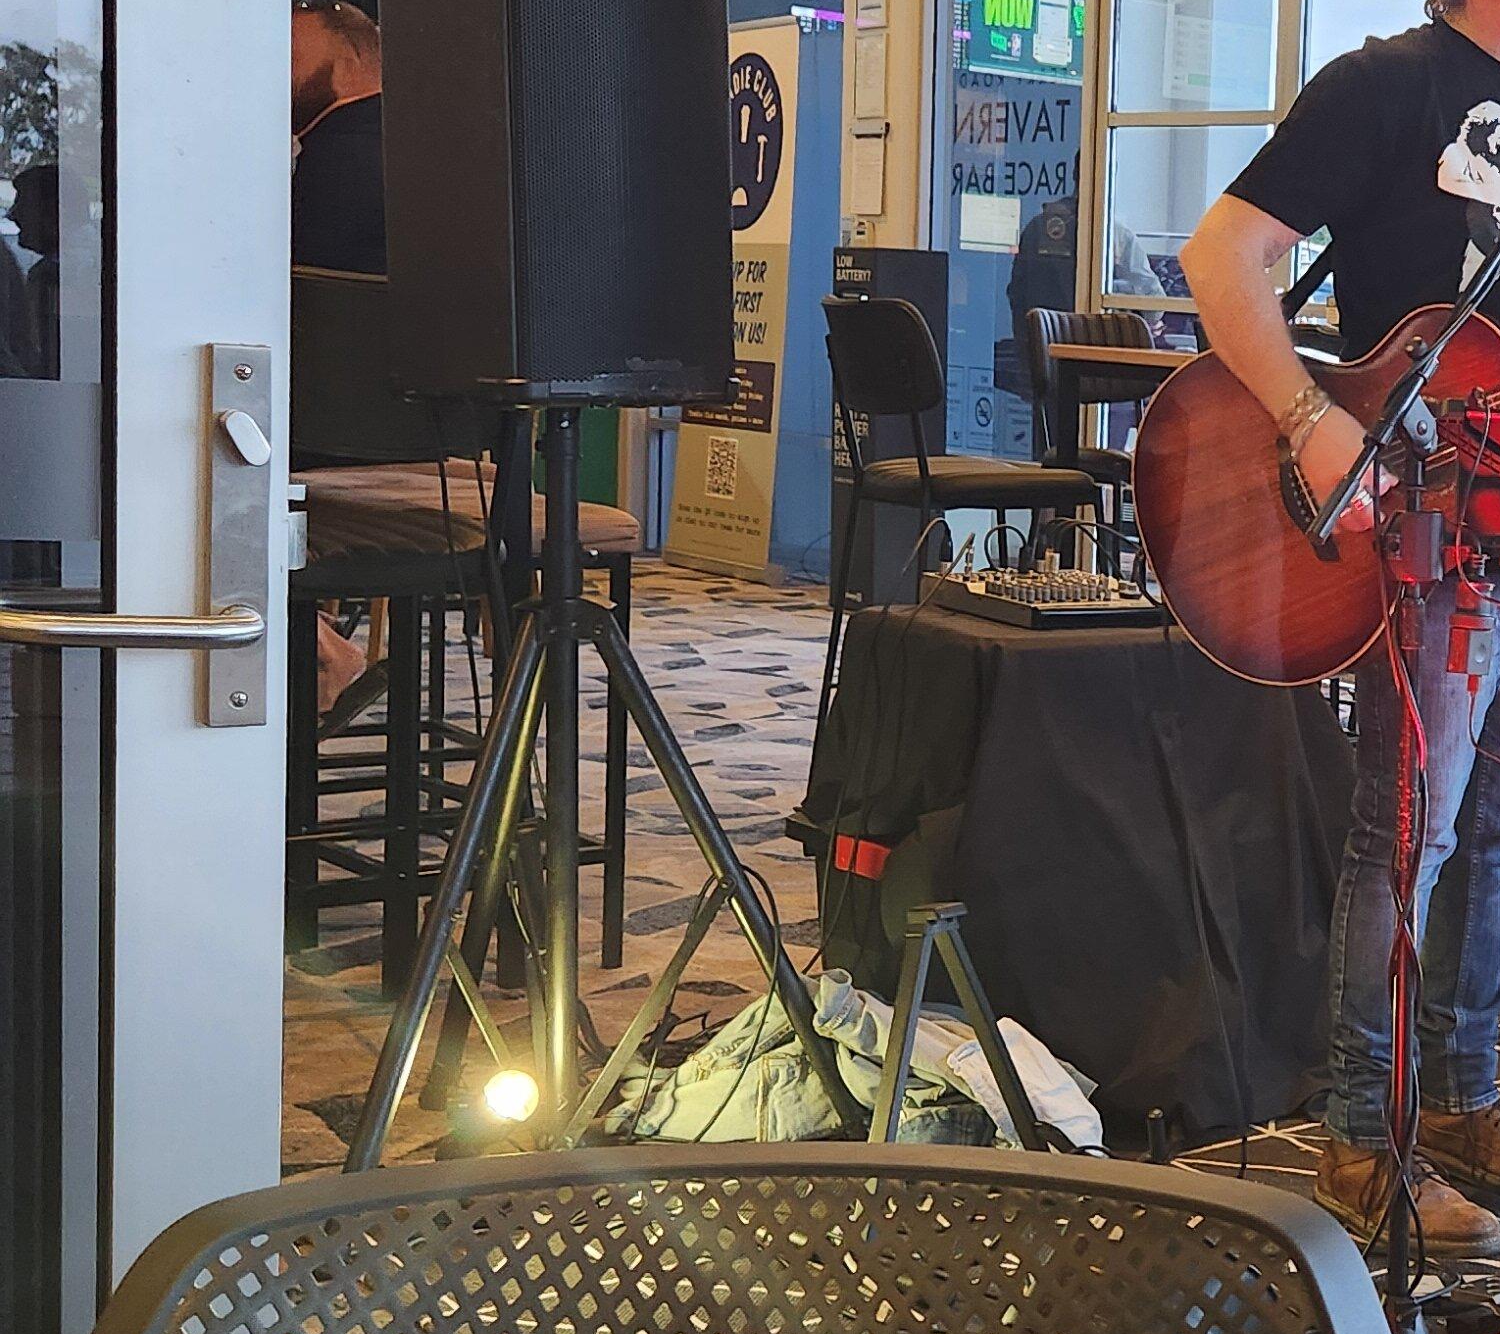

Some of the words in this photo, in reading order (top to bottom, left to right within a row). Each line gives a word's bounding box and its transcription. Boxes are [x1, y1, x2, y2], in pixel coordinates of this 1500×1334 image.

[752, 69, 778, 123] CLUB
[746, 260, 768, 284] FOR
[836, 255, 854, 268] LOW
[836, 269, 872, 283] BATTERY?
[733, 291, 764, 313] FIRST
[747, 321, 768, 346] US!
[834, 419, 869, 436] POER
